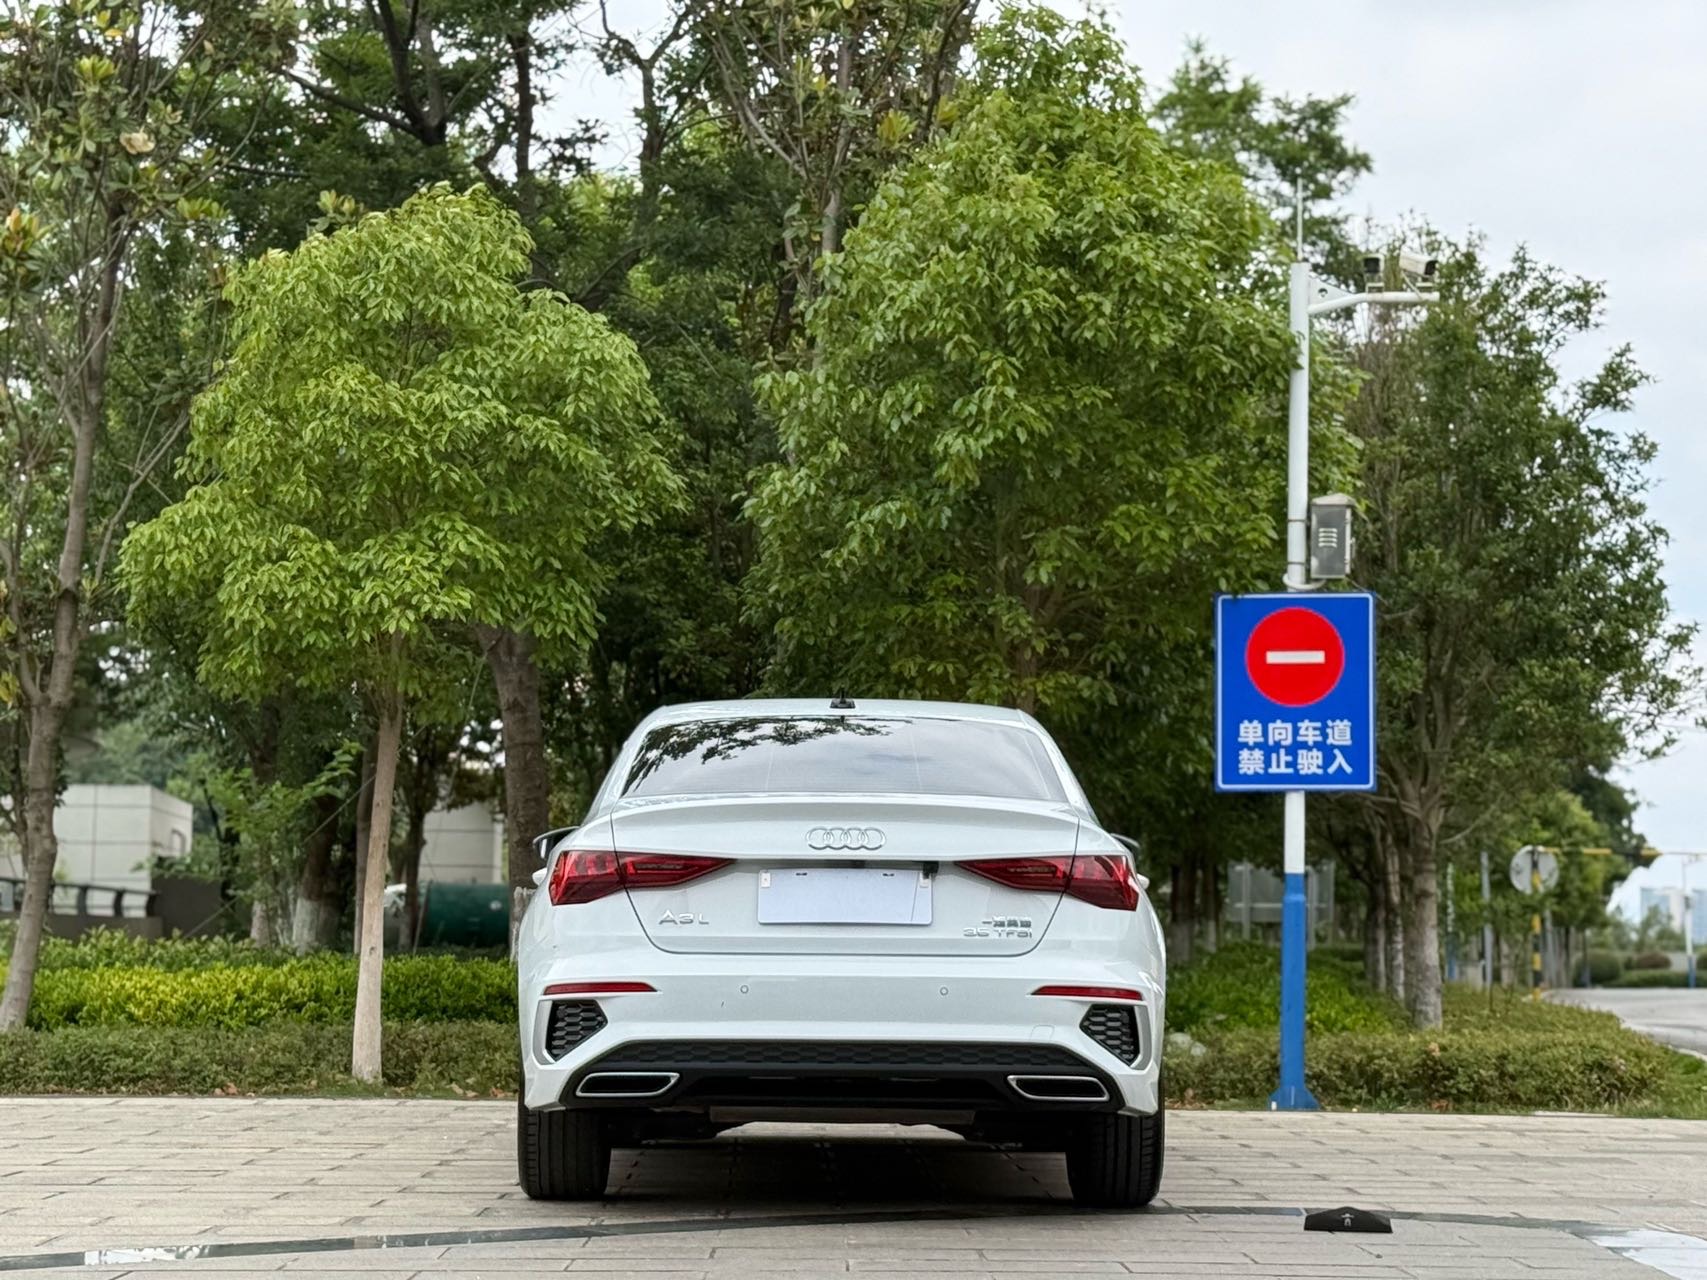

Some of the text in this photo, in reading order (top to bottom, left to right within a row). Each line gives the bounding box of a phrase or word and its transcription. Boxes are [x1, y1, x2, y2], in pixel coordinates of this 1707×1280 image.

[1238, 719, 1353, 746] 单向车道
[1238, 748, 1353, 775] 禁止驶入
